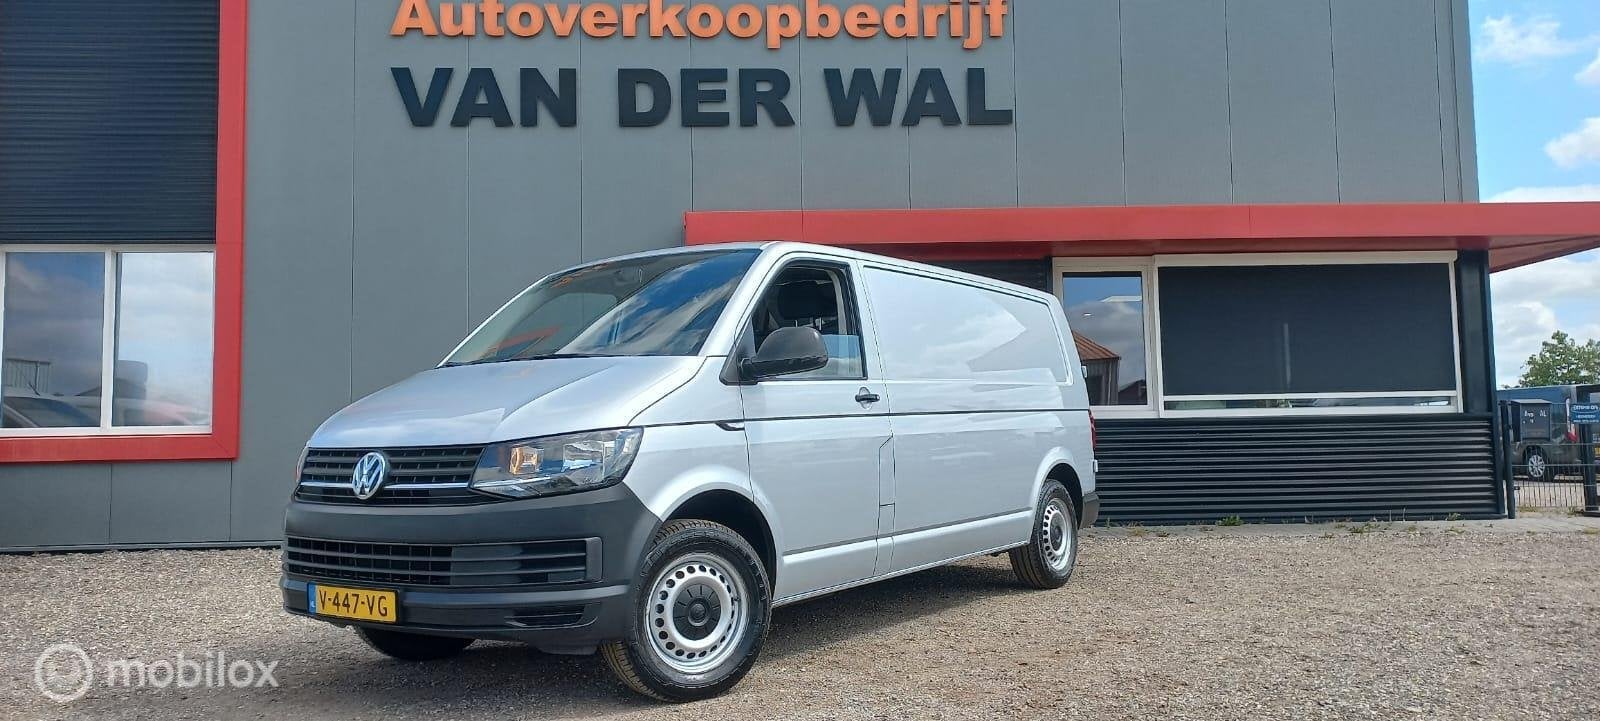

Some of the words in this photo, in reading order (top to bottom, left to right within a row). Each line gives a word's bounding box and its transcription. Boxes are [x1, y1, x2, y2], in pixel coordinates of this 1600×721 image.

[389, 0, 1008, 48] Autoverkoopbedrijf
[390, 67, 577, 127] VAN
[617, 68, 796, 127] DER
[823, 68, 1013, 126] WAL
[353, 452, 385, 499] VW
[319, 590, 388, 617] V-447-VG
